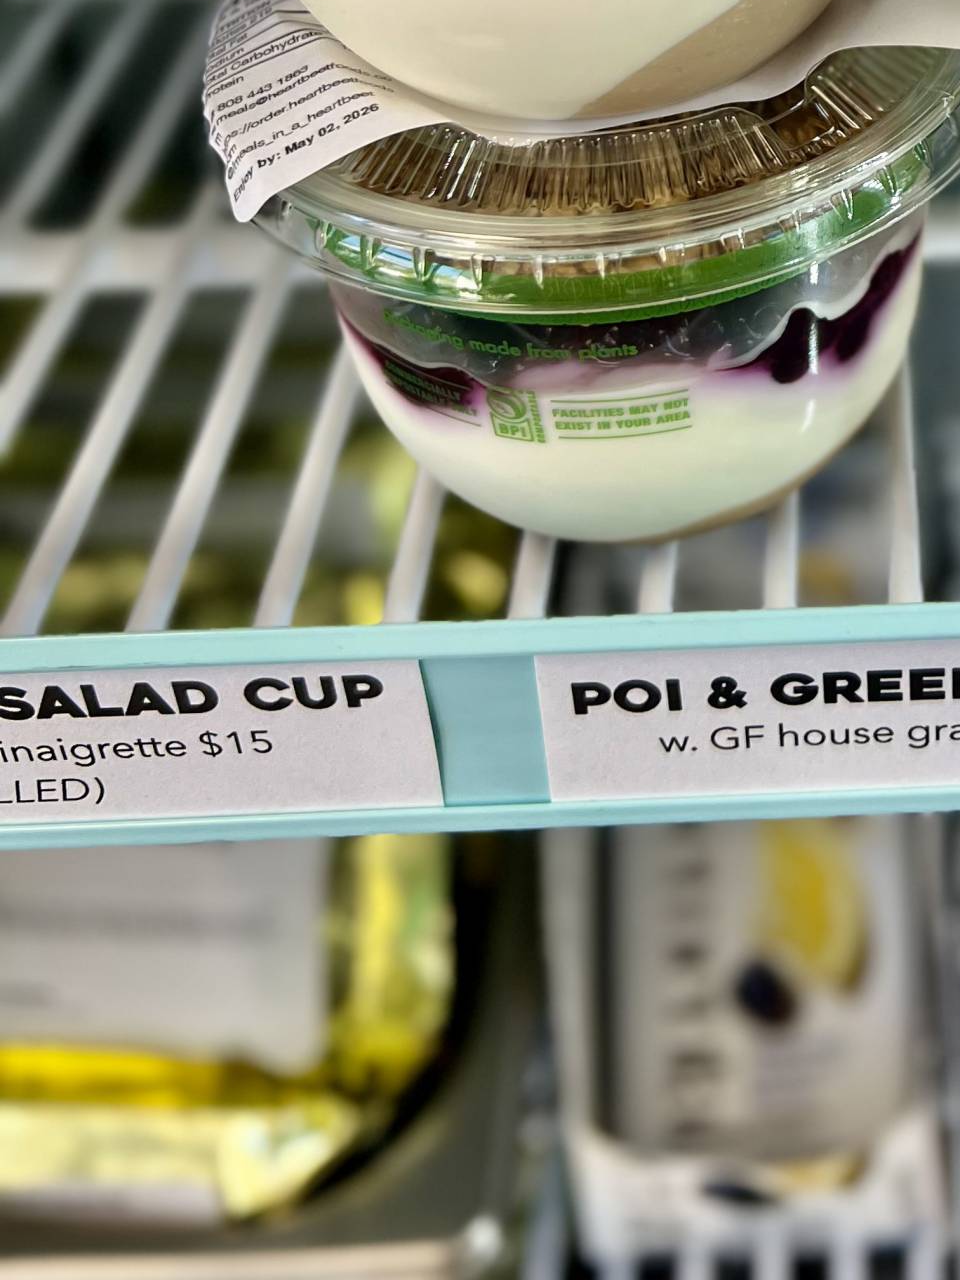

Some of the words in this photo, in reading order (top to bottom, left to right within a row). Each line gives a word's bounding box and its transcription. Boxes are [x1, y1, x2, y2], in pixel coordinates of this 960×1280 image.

[207, 75, 244, 98] rotein
[217, 95, 244, 111] 808
[247, 83, 273, 98] 443
[257, 151, 282, 168] by:
[284, 134, 314, 155] May
[318, 123, 341, 137] 02,
[343, 103, 380, 125] 2026
[469, 340, 522, 357] made
[526, 342, 571, 360] from
[579, 342, 639, 364] plants
[552, 407, 626, 419] FACILITIES
[628, 403, 659, 416] MAY
[554, 421, 593, 431] EXIST
[596, 420, 612, 431] IN
[615, 417, 651, 430] YOUR
[656, 411, 691, 425] AREA
[498, 423, 529, 438] BPI
[0, 680, 219, 721] SALAD
[243, 674, 384, 712] CUP
[570, 679, 683, 716] POI
[706, 676, 748, 710] &
[199, 729, 274, 758] $15
[659, 734, 699, 753] w.
[709, 725, 766, 751] GF
[778, 721, 895, 748] house
